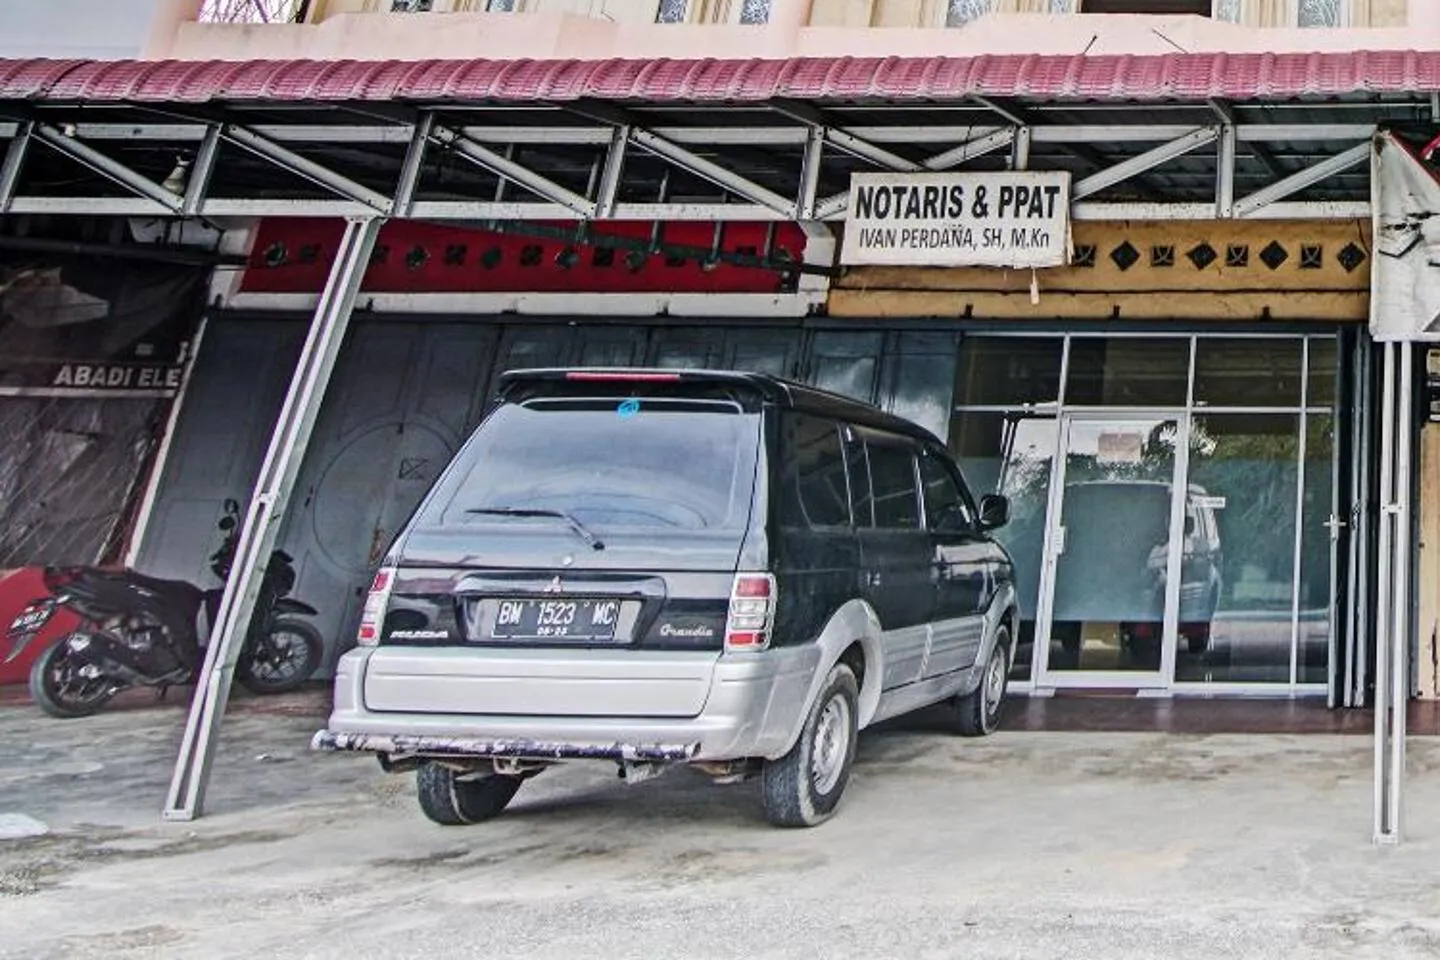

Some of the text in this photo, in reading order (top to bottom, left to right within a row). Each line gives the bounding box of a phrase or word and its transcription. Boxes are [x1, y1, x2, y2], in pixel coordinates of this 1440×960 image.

[855, 185, 1060, 219] NOTARIS & PPAT
[859, 228, 897, 248] IVAN
[982, 228, 1006, 250] SH,
[1010, 227, 1050, 249] M.Kn
[54, 365, 181, 387] ABADI ELE
[499, 601, 616, 625] BM 1523 MC
[659, 623, 714, 637] Grandia
